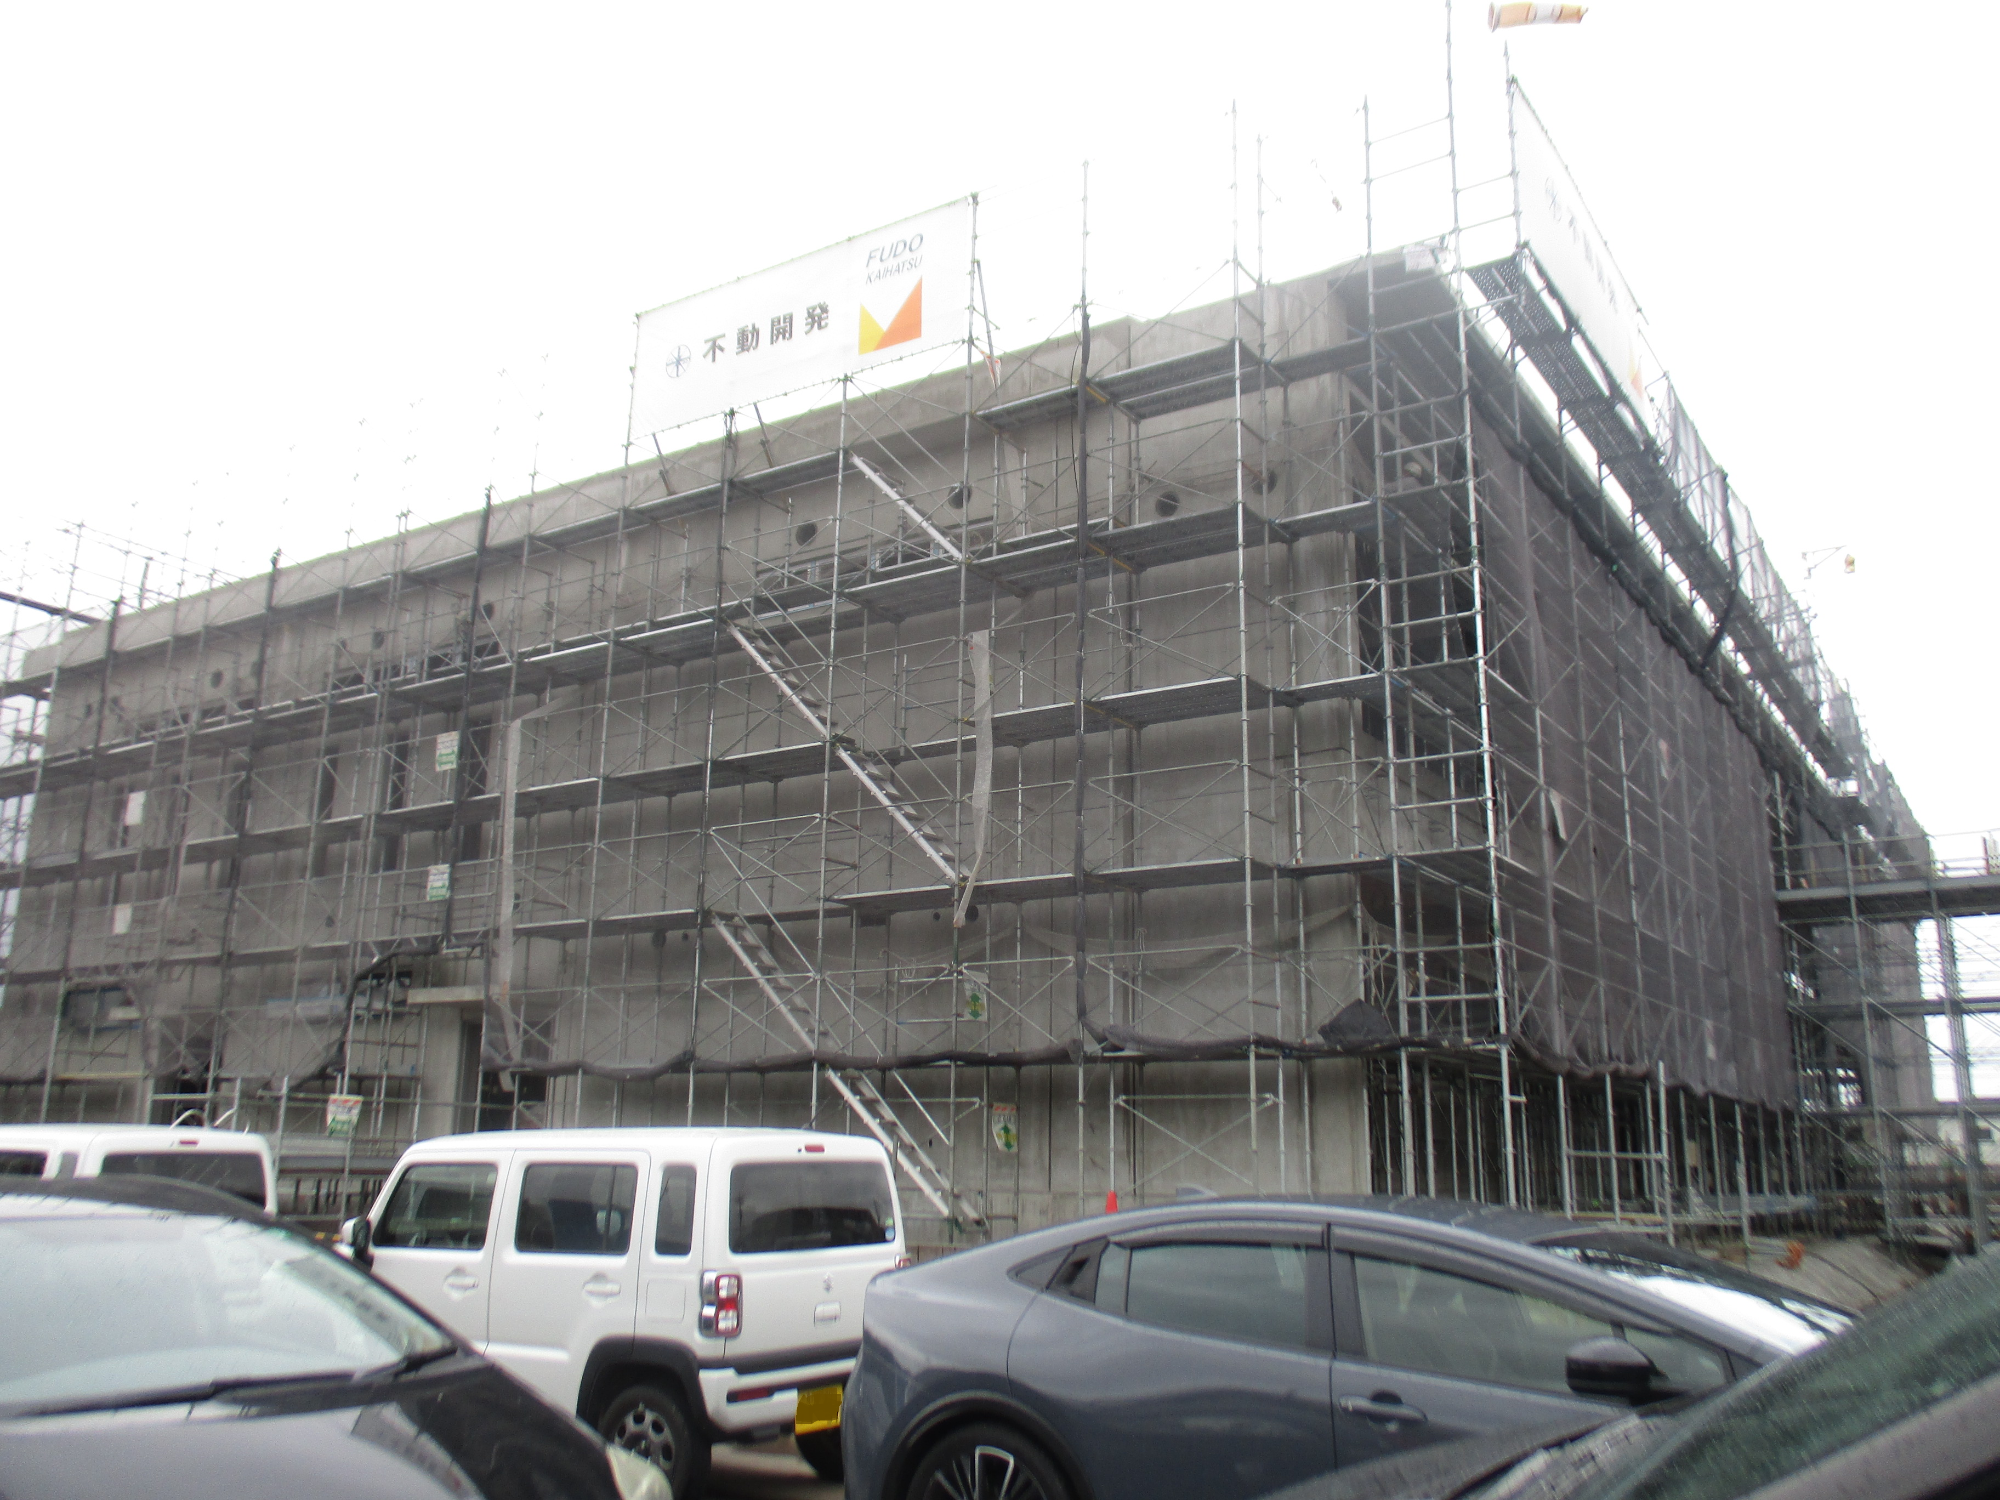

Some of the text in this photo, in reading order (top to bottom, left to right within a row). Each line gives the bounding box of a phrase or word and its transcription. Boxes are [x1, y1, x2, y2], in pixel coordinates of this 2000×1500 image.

[866, 233, 924, 268] FUDO
[865, 254, 923, 285] KAIHATSU
[702, 301, 830, 363] 不動開発
